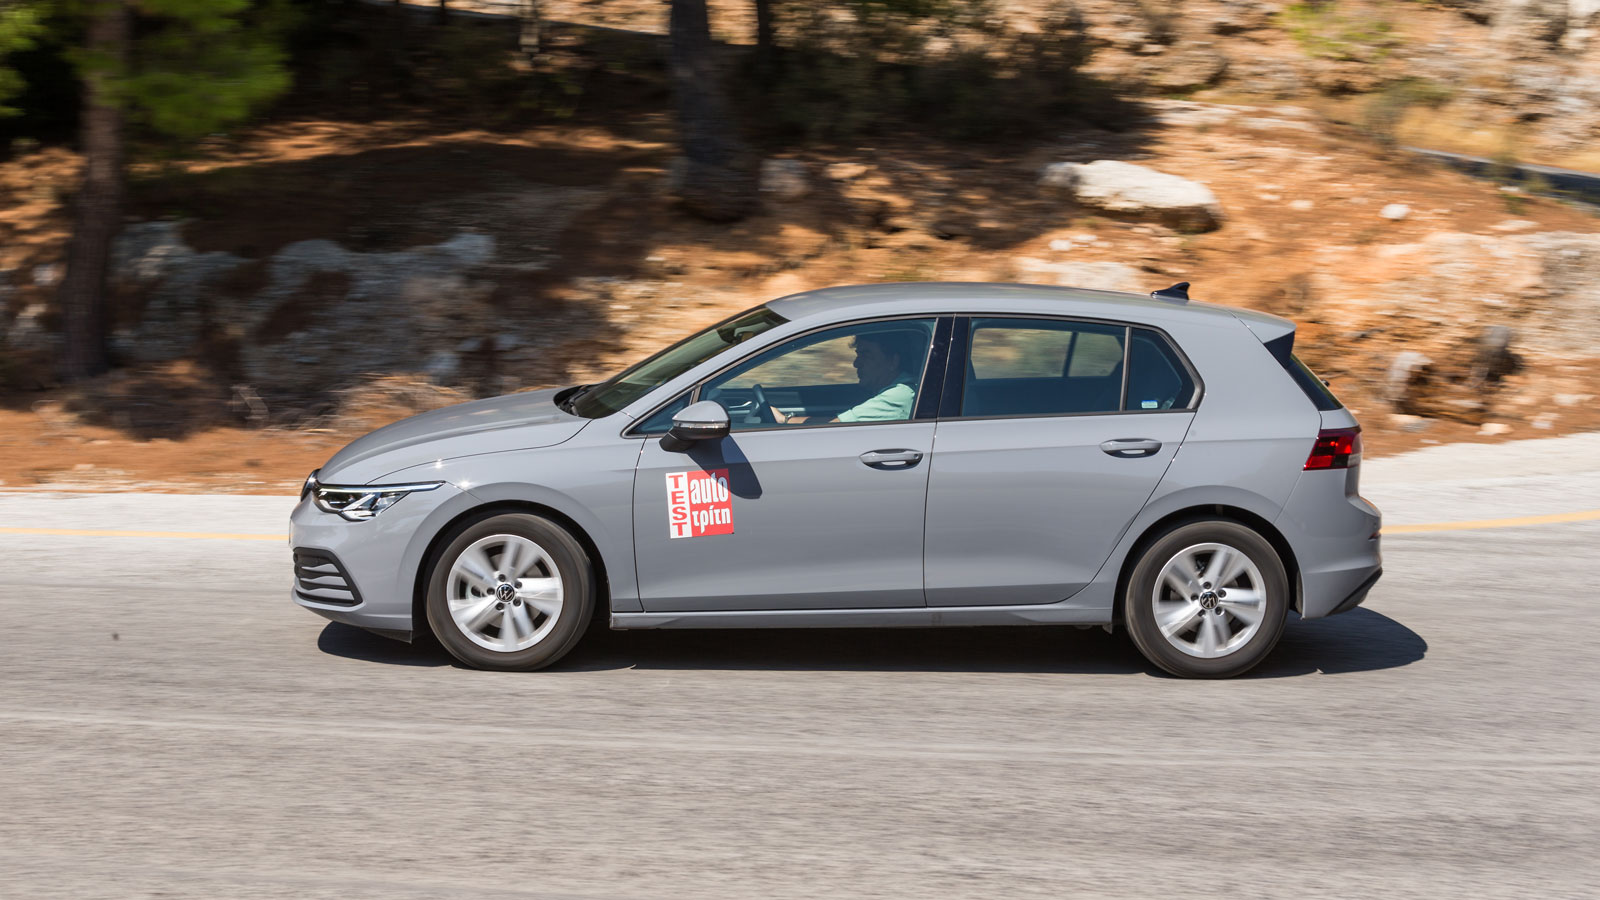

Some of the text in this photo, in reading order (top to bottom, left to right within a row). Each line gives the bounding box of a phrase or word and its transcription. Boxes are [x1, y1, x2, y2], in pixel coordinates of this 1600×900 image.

[689, 472, 729, 505] auto
[668, 474, 688, 537] TEST
[691, 505, 731, 534] τρίτη
